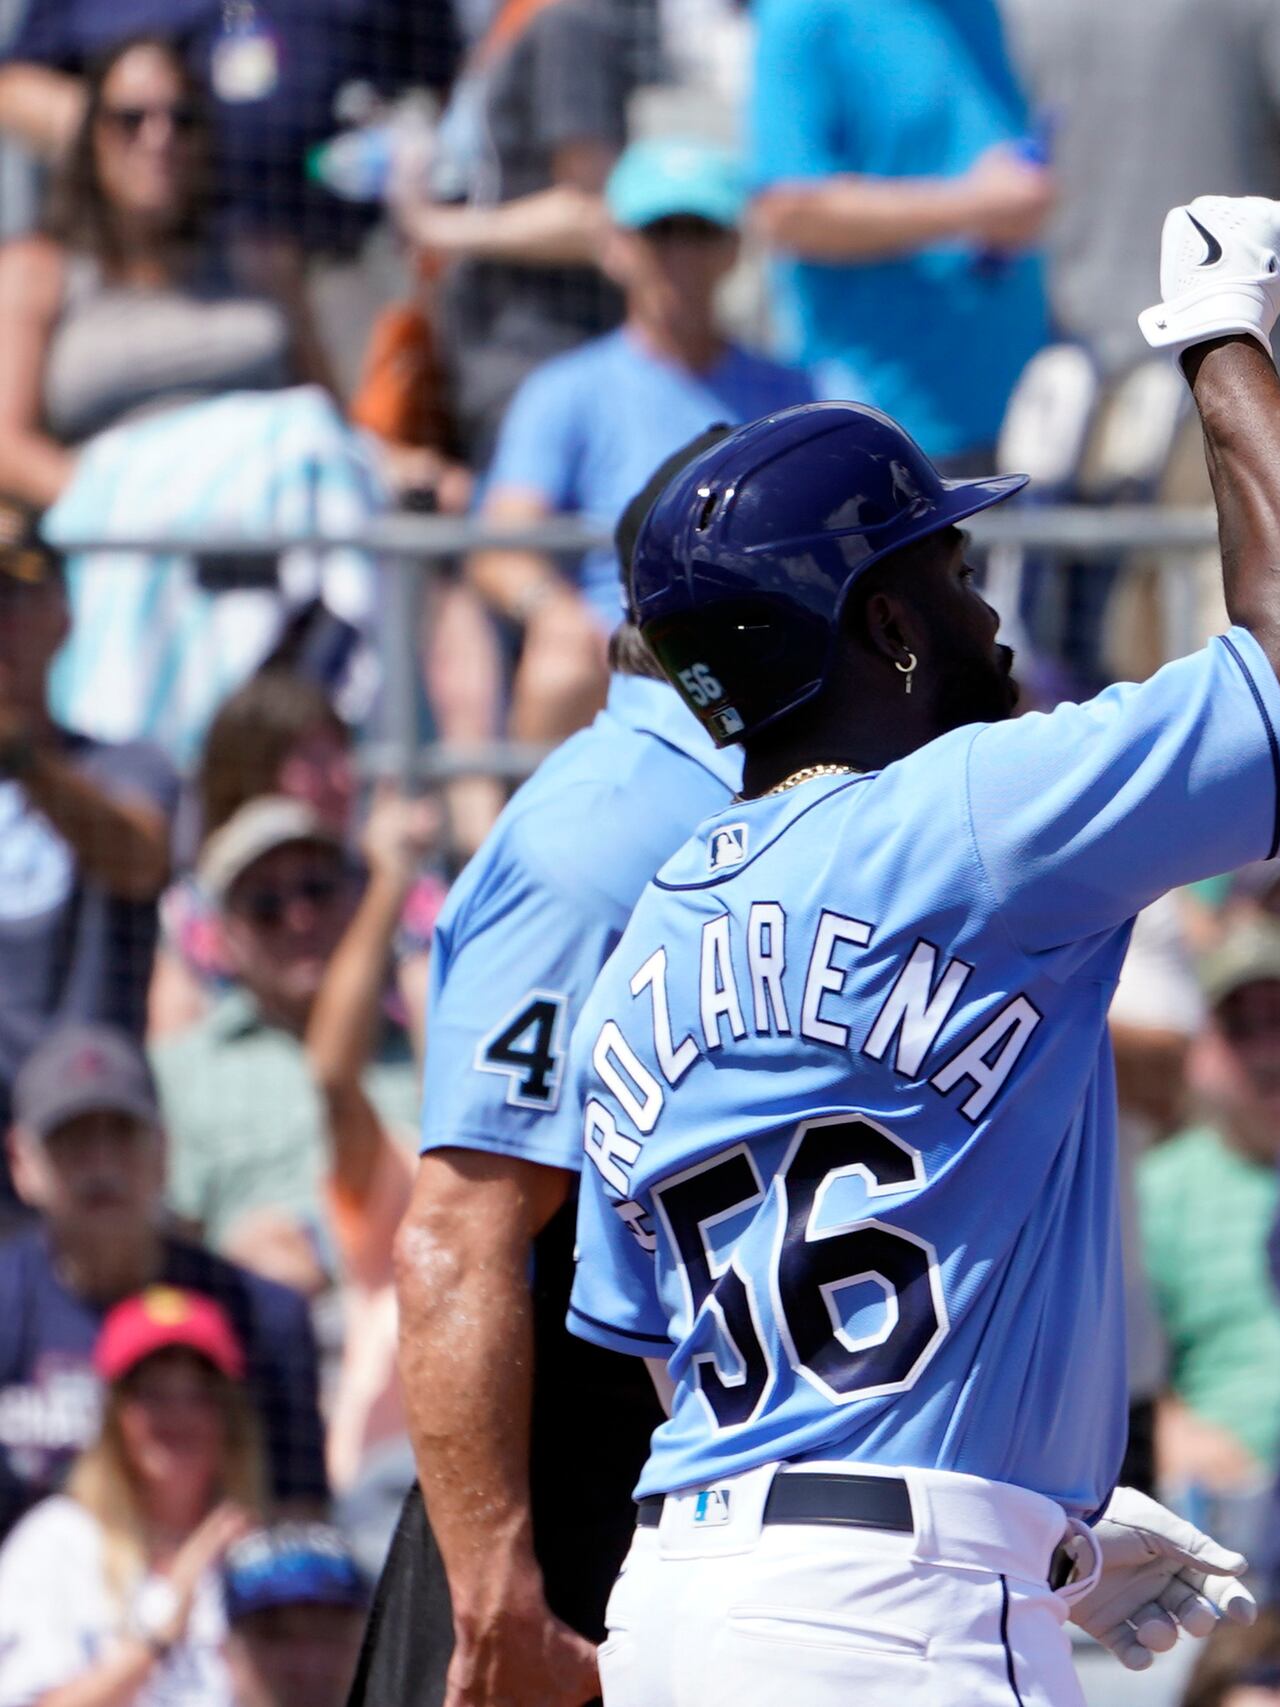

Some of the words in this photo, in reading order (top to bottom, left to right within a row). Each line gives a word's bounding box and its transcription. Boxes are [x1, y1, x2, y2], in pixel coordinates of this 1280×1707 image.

[677, 662, 723, 707] 56
[473, 987, 568, 1113] 4
[650, 1113, 950, 1439] 56
